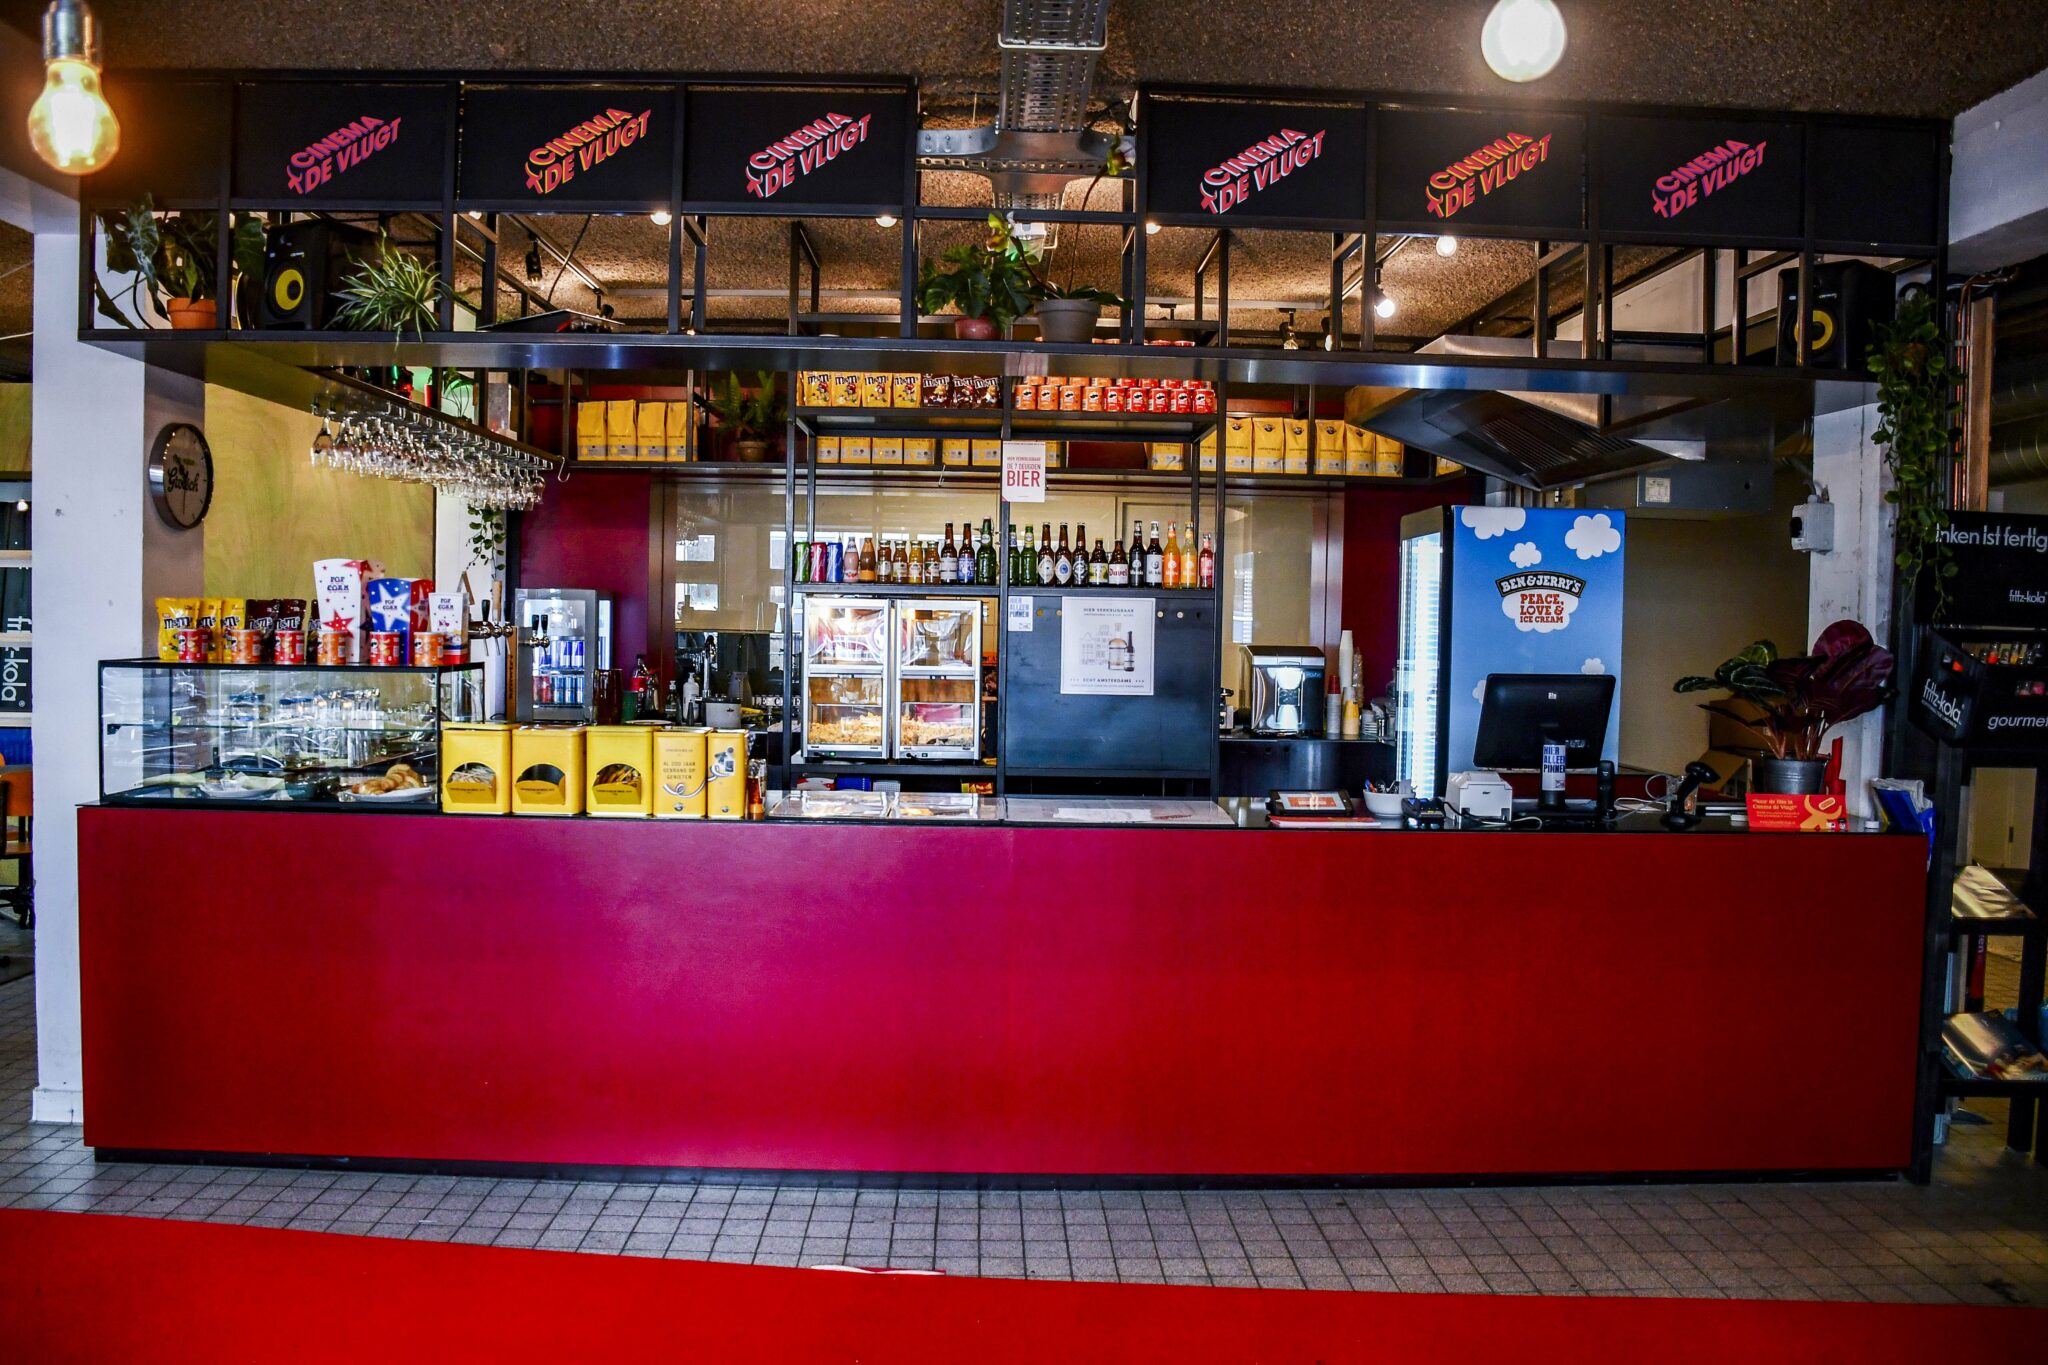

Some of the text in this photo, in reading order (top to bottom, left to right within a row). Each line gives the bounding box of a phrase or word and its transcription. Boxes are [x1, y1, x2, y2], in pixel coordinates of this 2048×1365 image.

[290, 115, 384, 169] CINEMA
[303, 117, 401, 194] DE VLUGT
[529, 108, 633, 167] CINEMA
[544, 109, 651, 194] DE VLUGT
[749, 111, 853, 168] CINEMA
[765, 113, 872, 198] DE VLUGT
[1203, 127, 1308, 186] CINEMA
[1430, 131, 1533, 190] CINEMA
[1656, 139, 1750, 190] CINEMA
[1218, 129, 1326, 215] DE VLUGT
[1445, 133, 1552, 219] DE VLUGT
[1669, 141, 1767, 218] DE VLUGT
[1007, 471, 1040, 487] BIER
[1983, 525, 2001, 546] ist
[2003, 526, 2048, 553] fertig
[1501, 575, 1582, 593] BEN&JERRY'S
[1520, 594, 1564, 606] PEACE,
[1520, 605, 1564, 616] LOVE &
[2009, 590, 2046, 603] fritz-kola
[1923, 679, 1961, 723] fritz-kola
[1544, 746, 1560, 755] HIER
[1544, 755, 1566, 764] ALLEE
